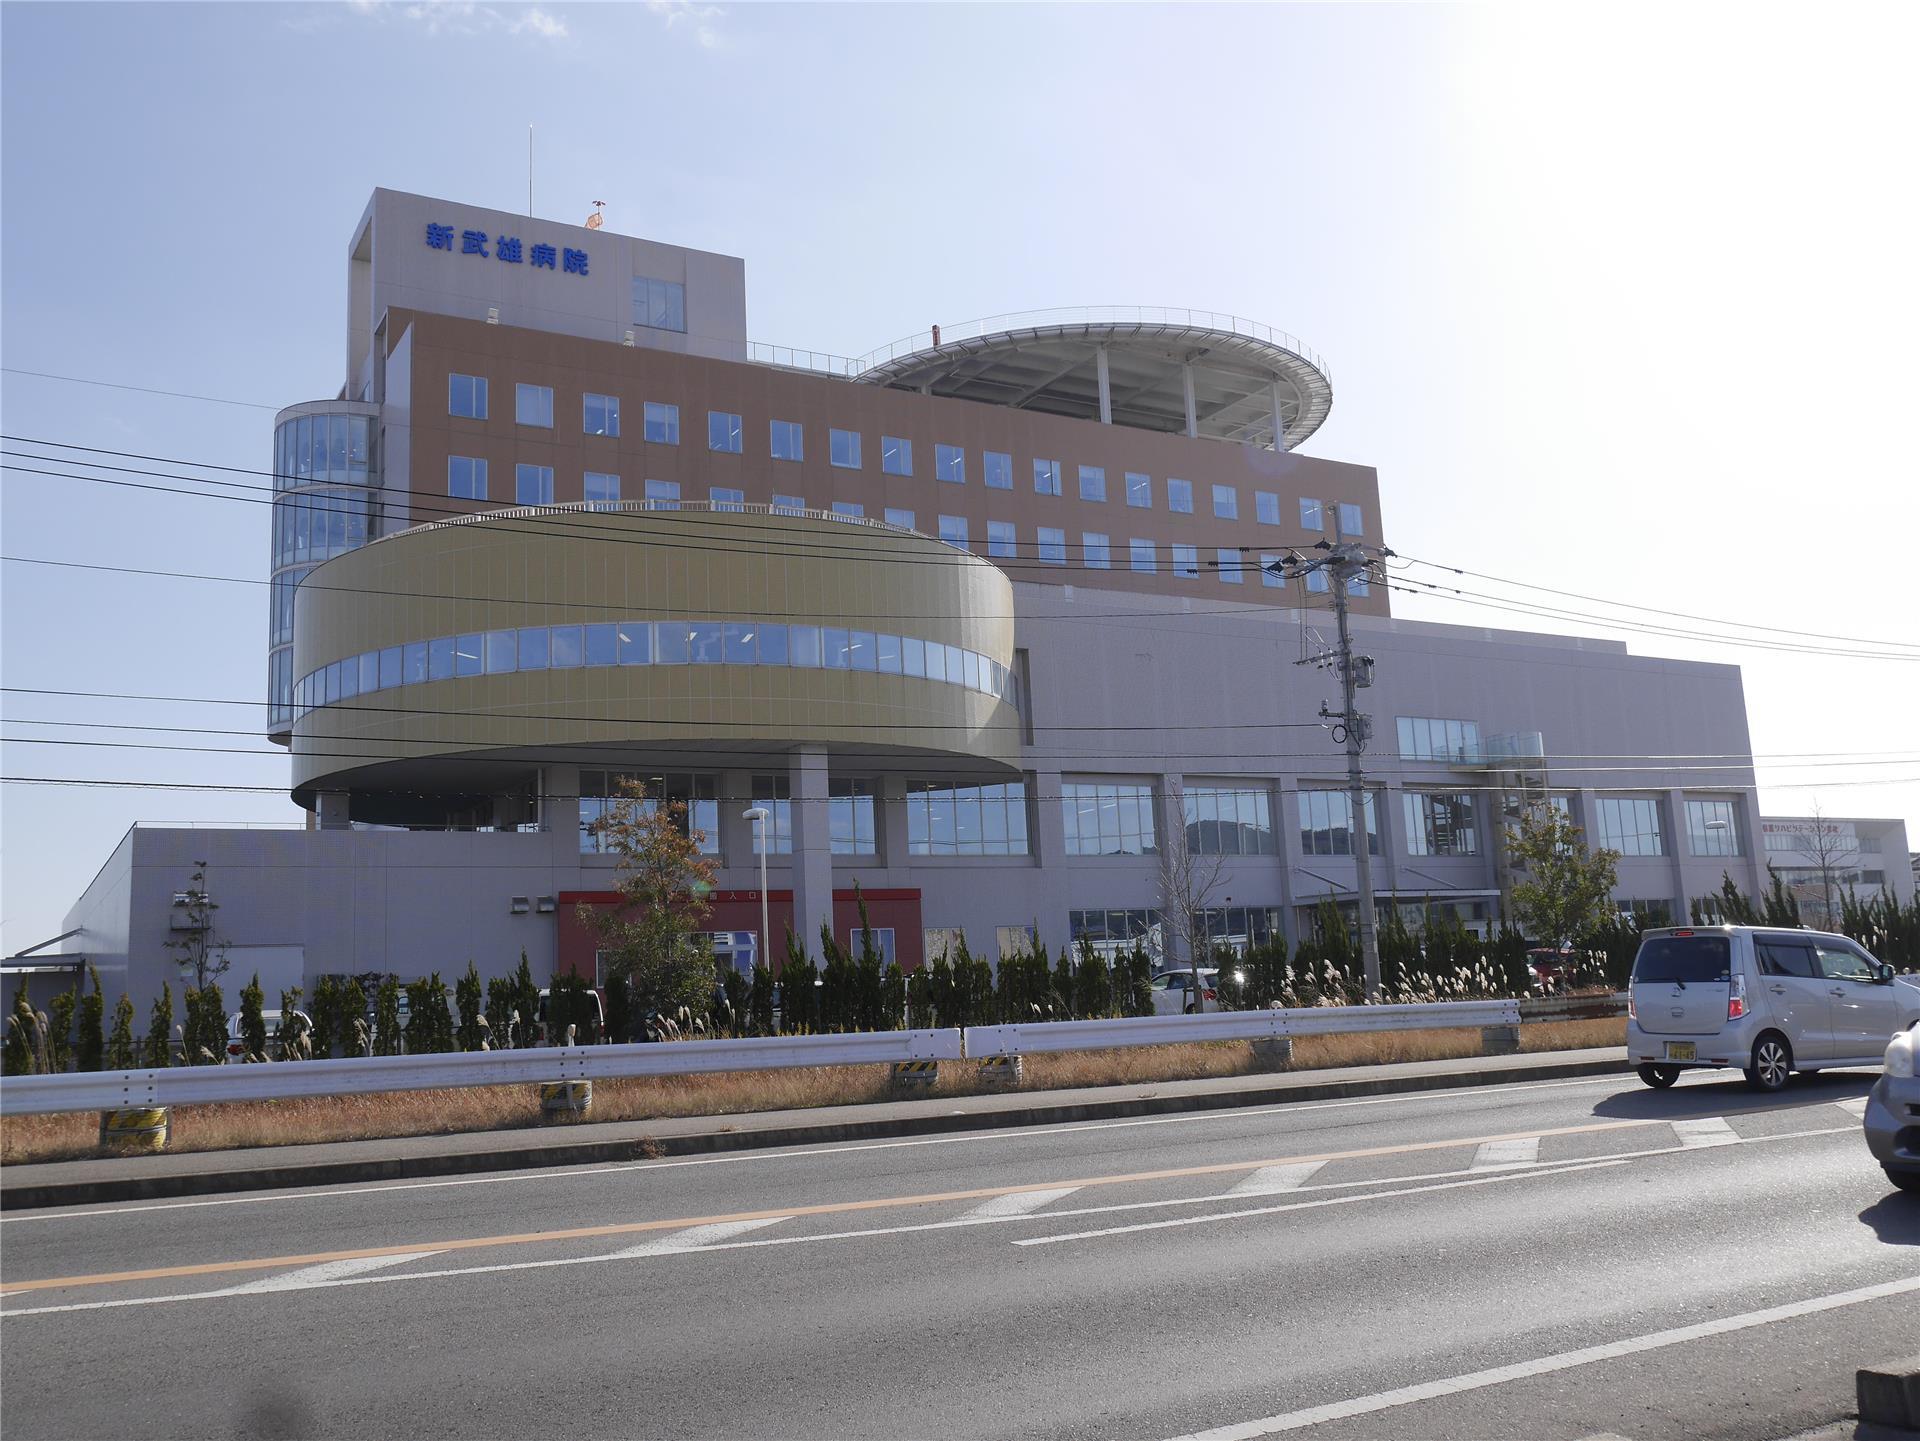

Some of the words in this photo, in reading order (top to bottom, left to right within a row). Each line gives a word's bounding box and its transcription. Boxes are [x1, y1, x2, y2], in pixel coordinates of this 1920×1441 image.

[426, 222, 589, 276] 新武雄病院
